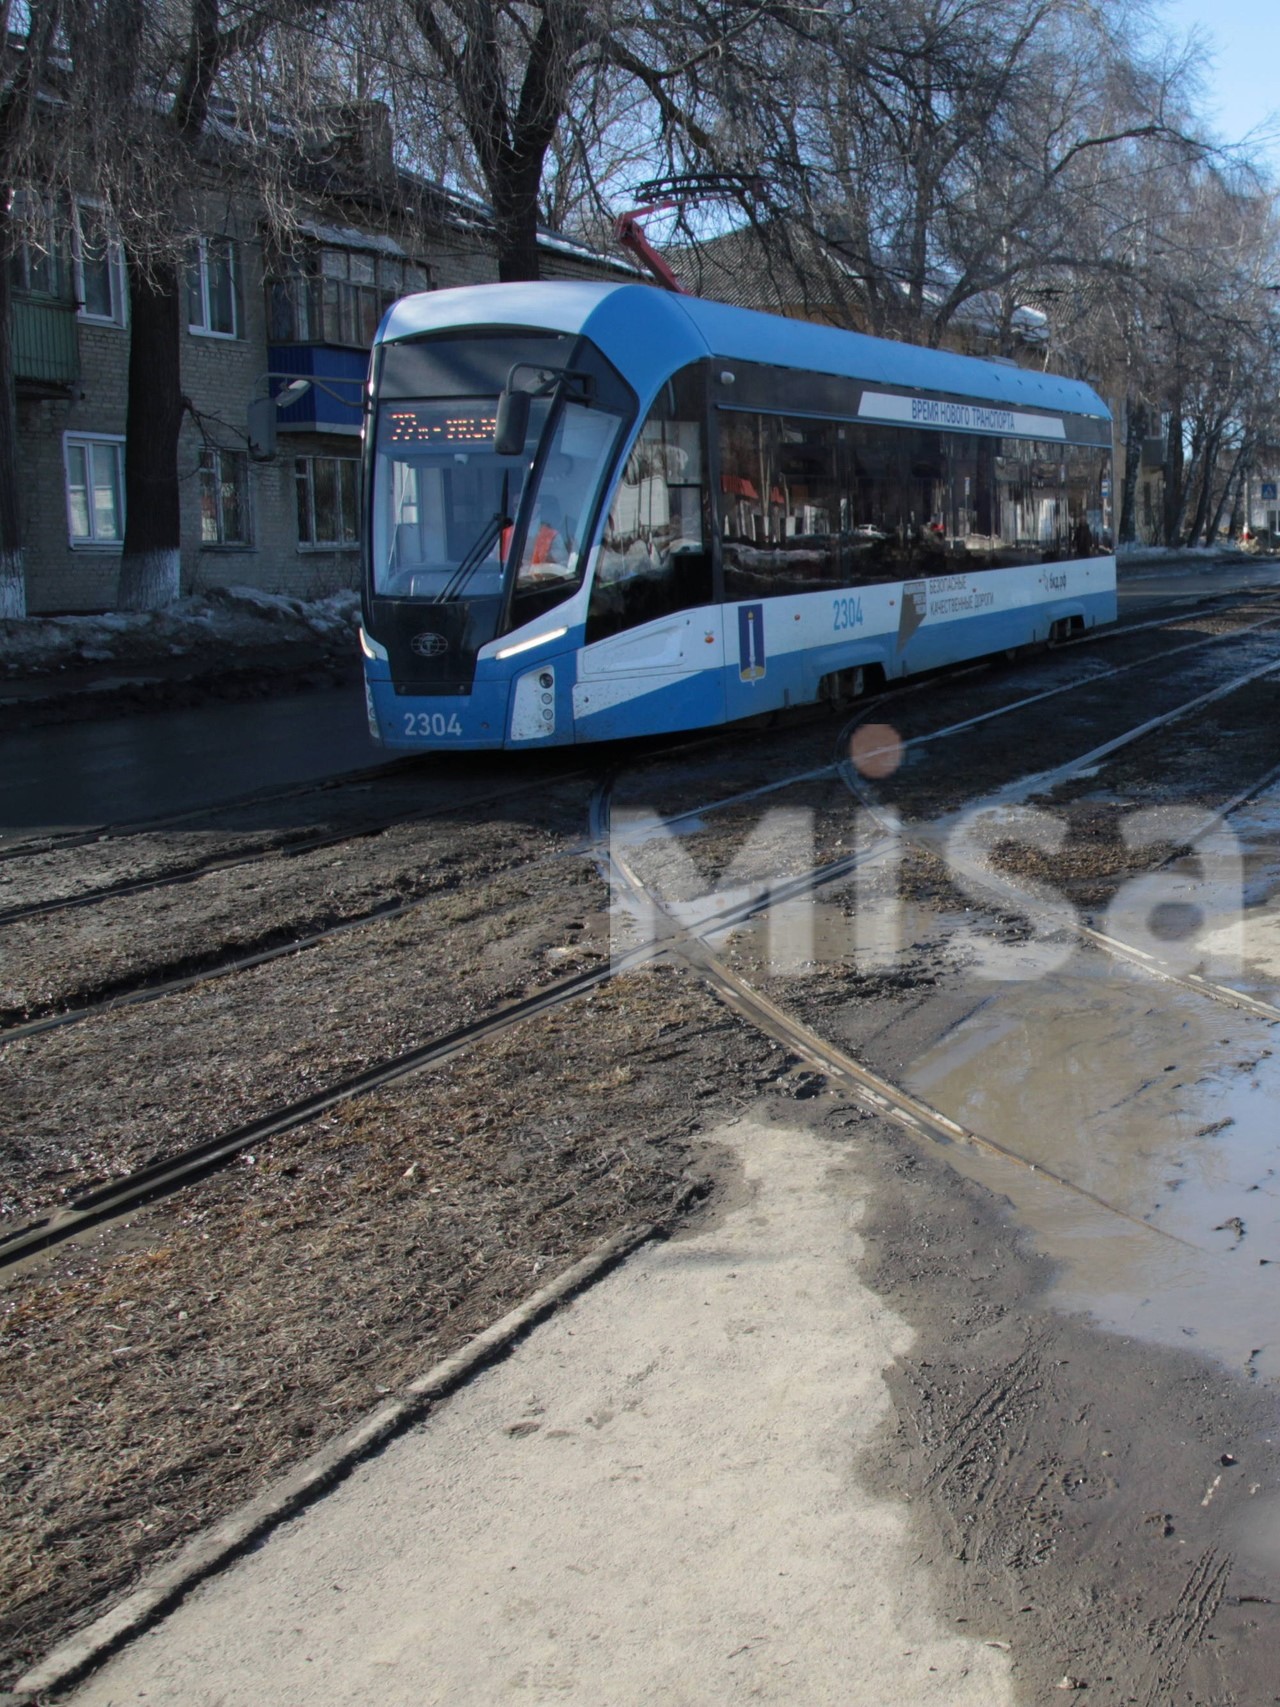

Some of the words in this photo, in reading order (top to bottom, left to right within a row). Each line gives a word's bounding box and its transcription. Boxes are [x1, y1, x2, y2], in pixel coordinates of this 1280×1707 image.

[911, 400, 939, 421] ВРЕМЯ
[941, 405, 970, 426] НОВОГО
[972, 408, 1015, 430] ТРАНСПОРТА
[833, 596, 863, 631] 2304
[404, 712, 463, 736] 2304
